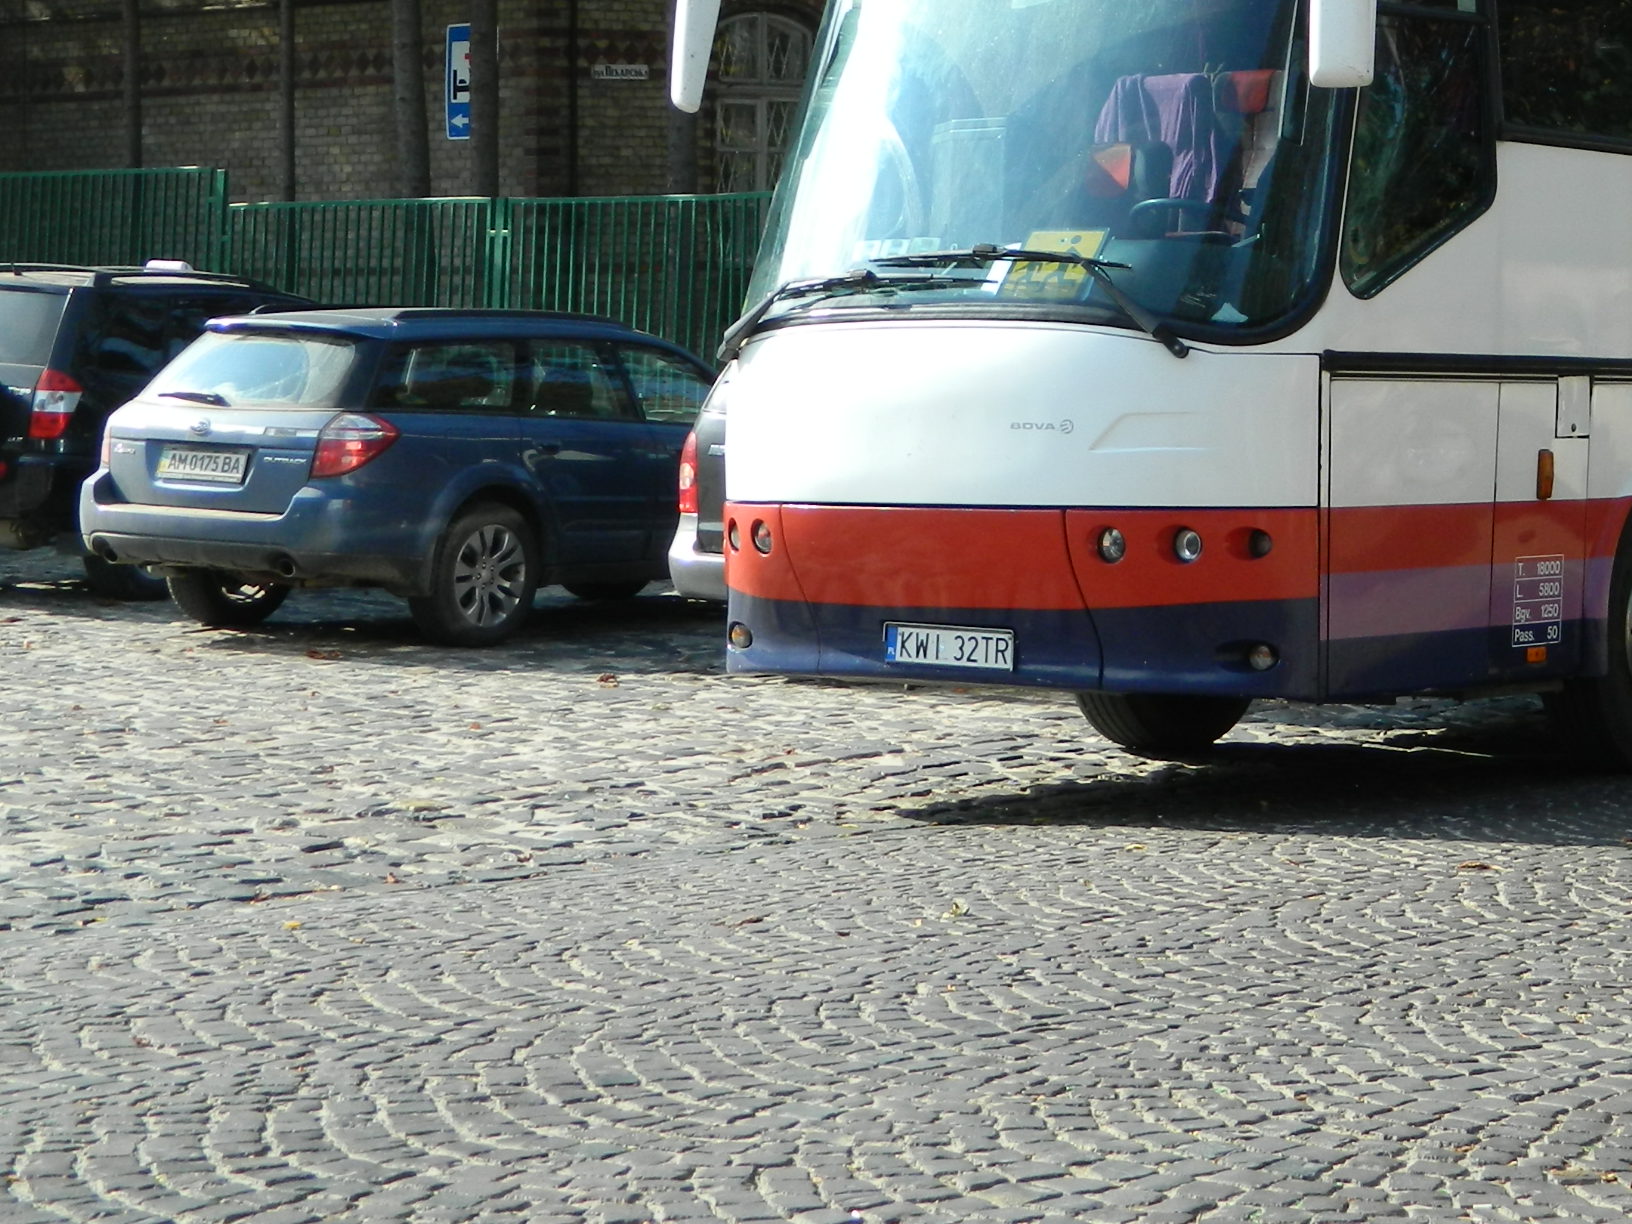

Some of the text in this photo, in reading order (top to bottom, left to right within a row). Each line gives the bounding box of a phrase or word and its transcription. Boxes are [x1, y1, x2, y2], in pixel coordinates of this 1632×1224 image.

[1010, 422, 1056, 431] BOVA
[167, 453, 240, 474] AM 0175 BA
[1536, 560, 1561, 576] 18000
[1538, 582, 1560, 597] 5800
[1540, 603, 1559, 618] 1250
[1546, 625, 1558, 640] 50
[899, 631, 1009, 665] KWI 32TR
